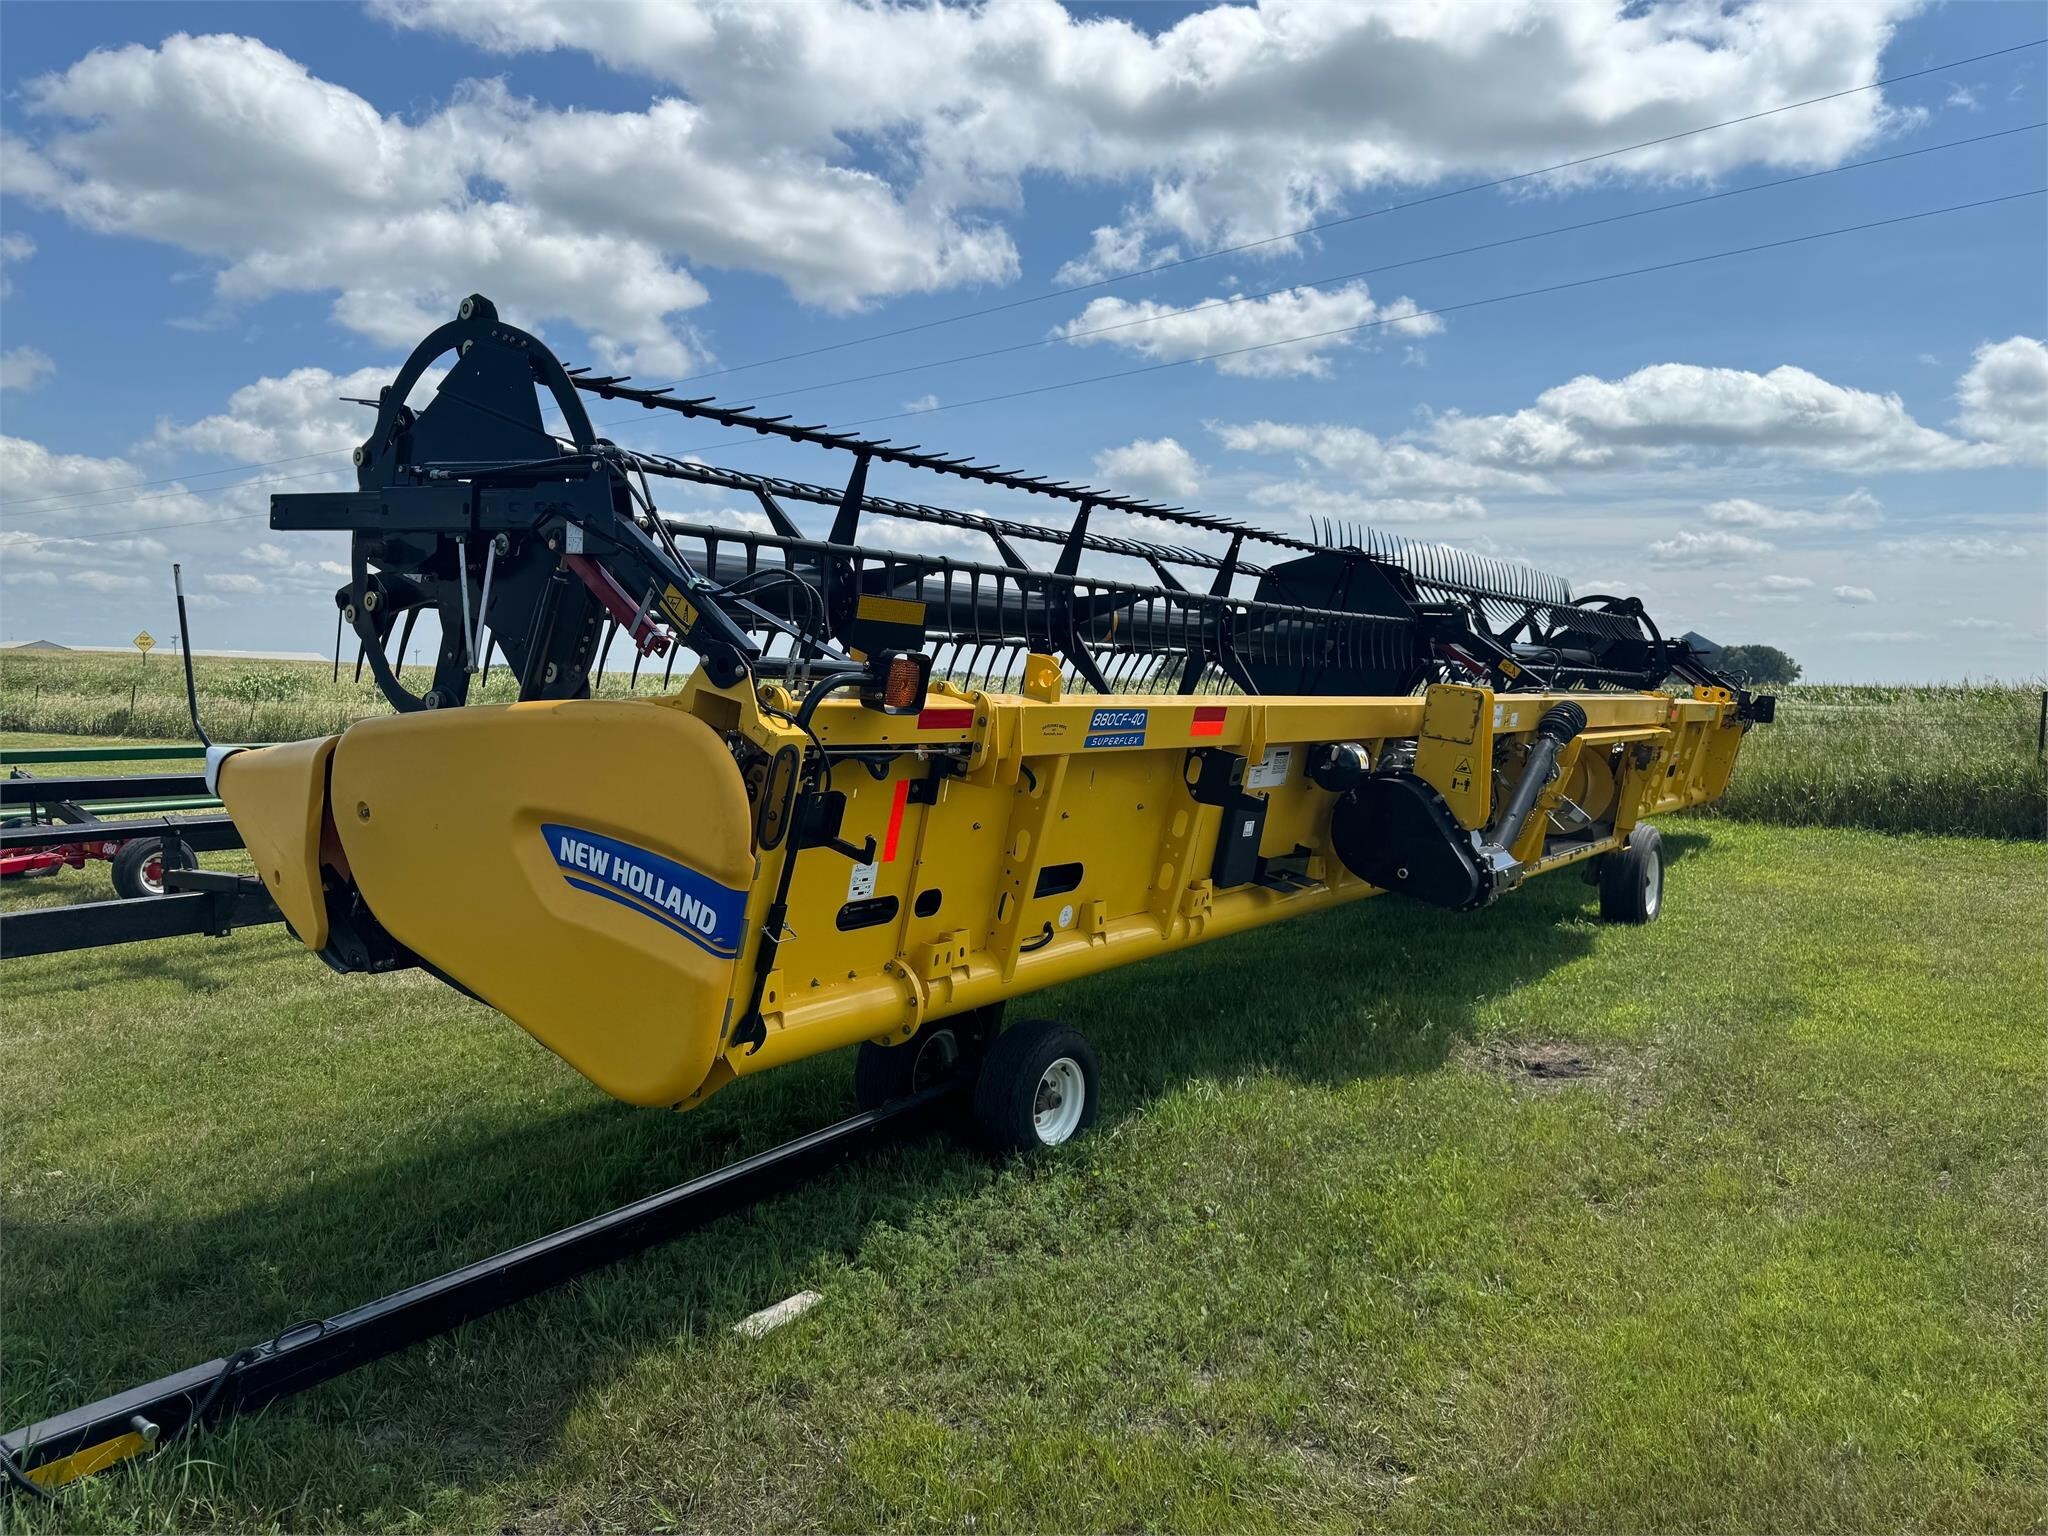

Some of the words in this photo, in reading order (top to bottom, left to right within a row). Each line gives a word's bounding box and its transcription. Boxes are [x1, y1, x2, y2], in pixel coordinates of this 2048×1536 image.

[1092, 712, 1146, 726] 880CF-40
[1091, 736, 1140, 746] SUPERFLEX
[559, 836, 610, 877] NEW
[612, 856, 717, 935] HOLLAND
